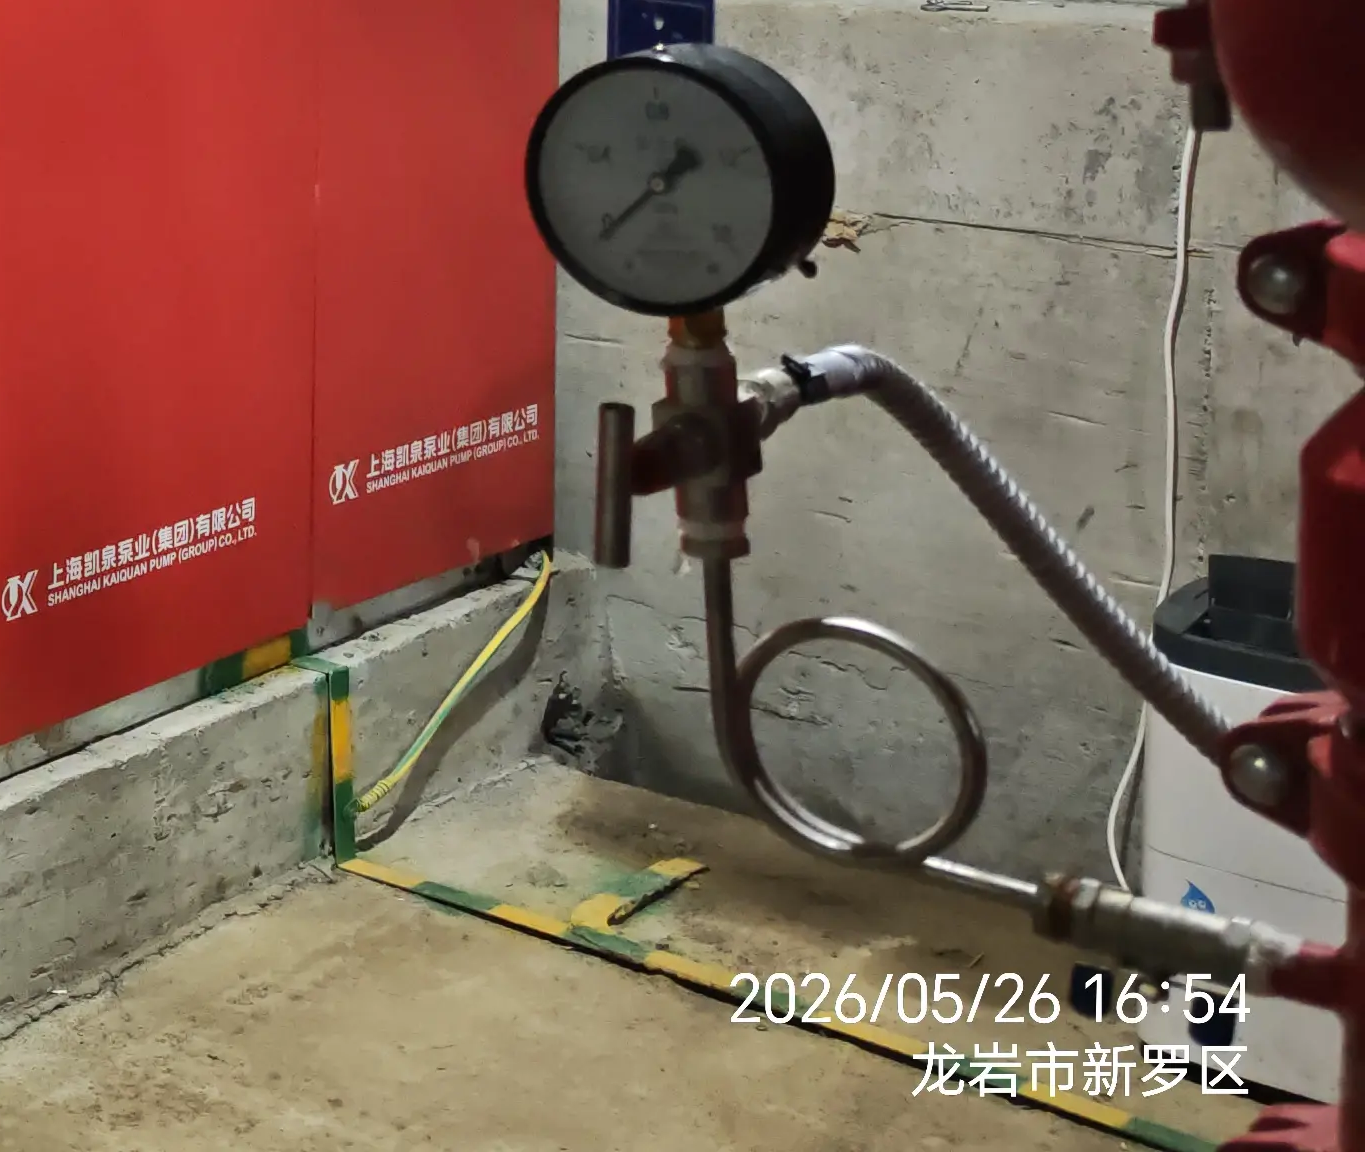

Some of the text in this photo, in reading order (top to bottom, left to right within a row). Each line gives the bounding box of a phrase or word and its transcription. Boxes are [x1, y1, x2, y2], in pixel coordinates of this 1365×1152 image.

[366, 403, 538, 478] 上海凯泉泵业(集团)有限公司
[366, 469, 410, 494] SHANGHAI
[411, 458, 448, 479] KAIQUAN
[449, 450, 472, 466] PUMP
[47, 496, 256, 590] 上海凯泉泵业(集团)有限公司
[47, 577, 101, 607] SHANGHAI
[102, 563, 147, 588] KAIQUAN
[149, 551, 176, 571] PUMP
[178, 536, 217, 564] (GROUP)
